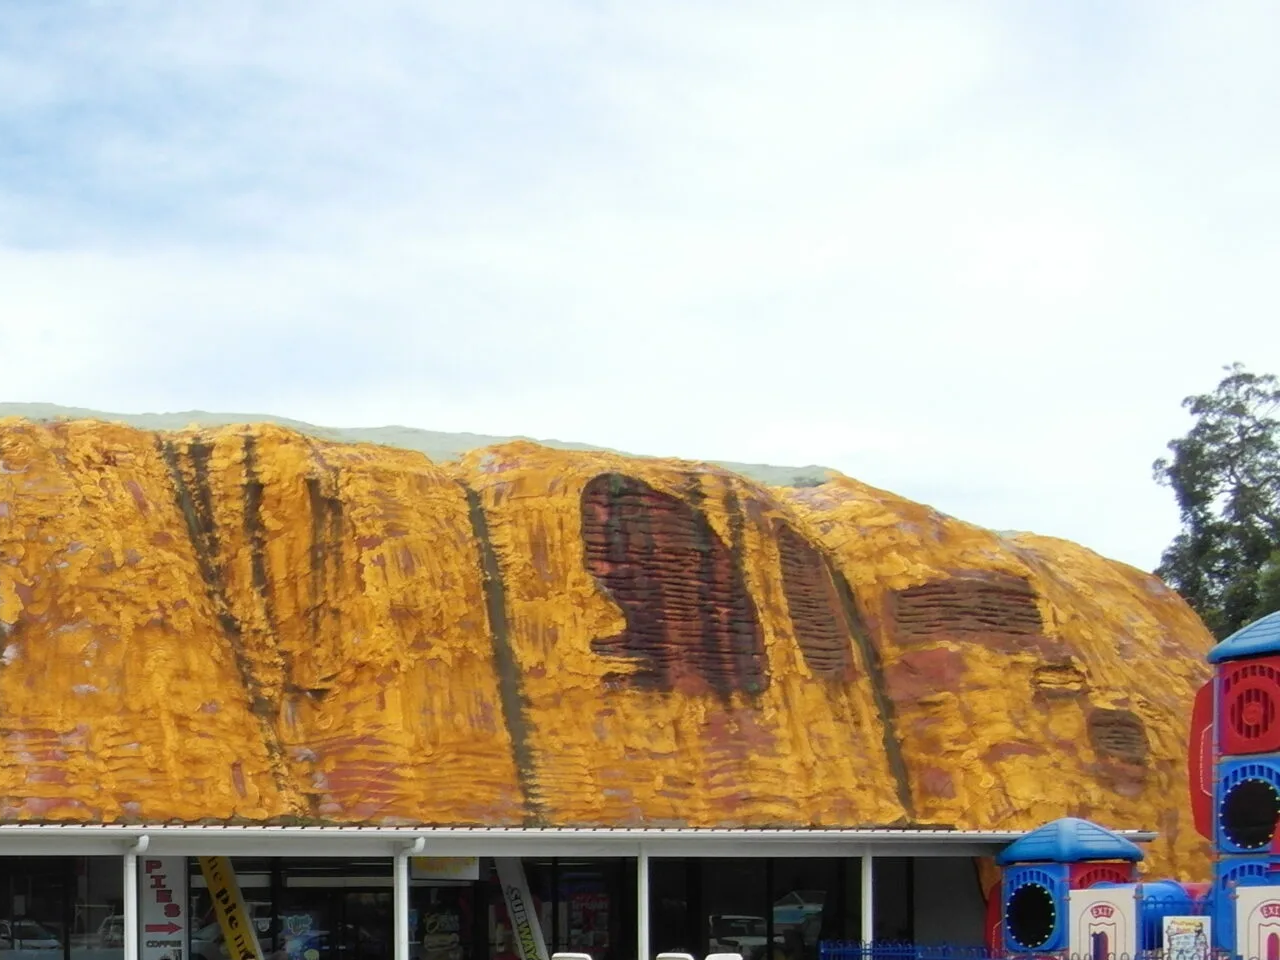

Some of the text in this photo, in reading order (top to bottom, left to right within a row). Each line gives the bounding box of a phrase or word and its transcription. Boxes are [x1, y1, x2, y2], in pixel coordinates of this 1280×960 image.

[145, 860, 181, 918] PIES
[215, 887, 238, 930] pie
[1091, 906, 1113, 918] EXIT
[1262, 905, 1280, 918] EXI
